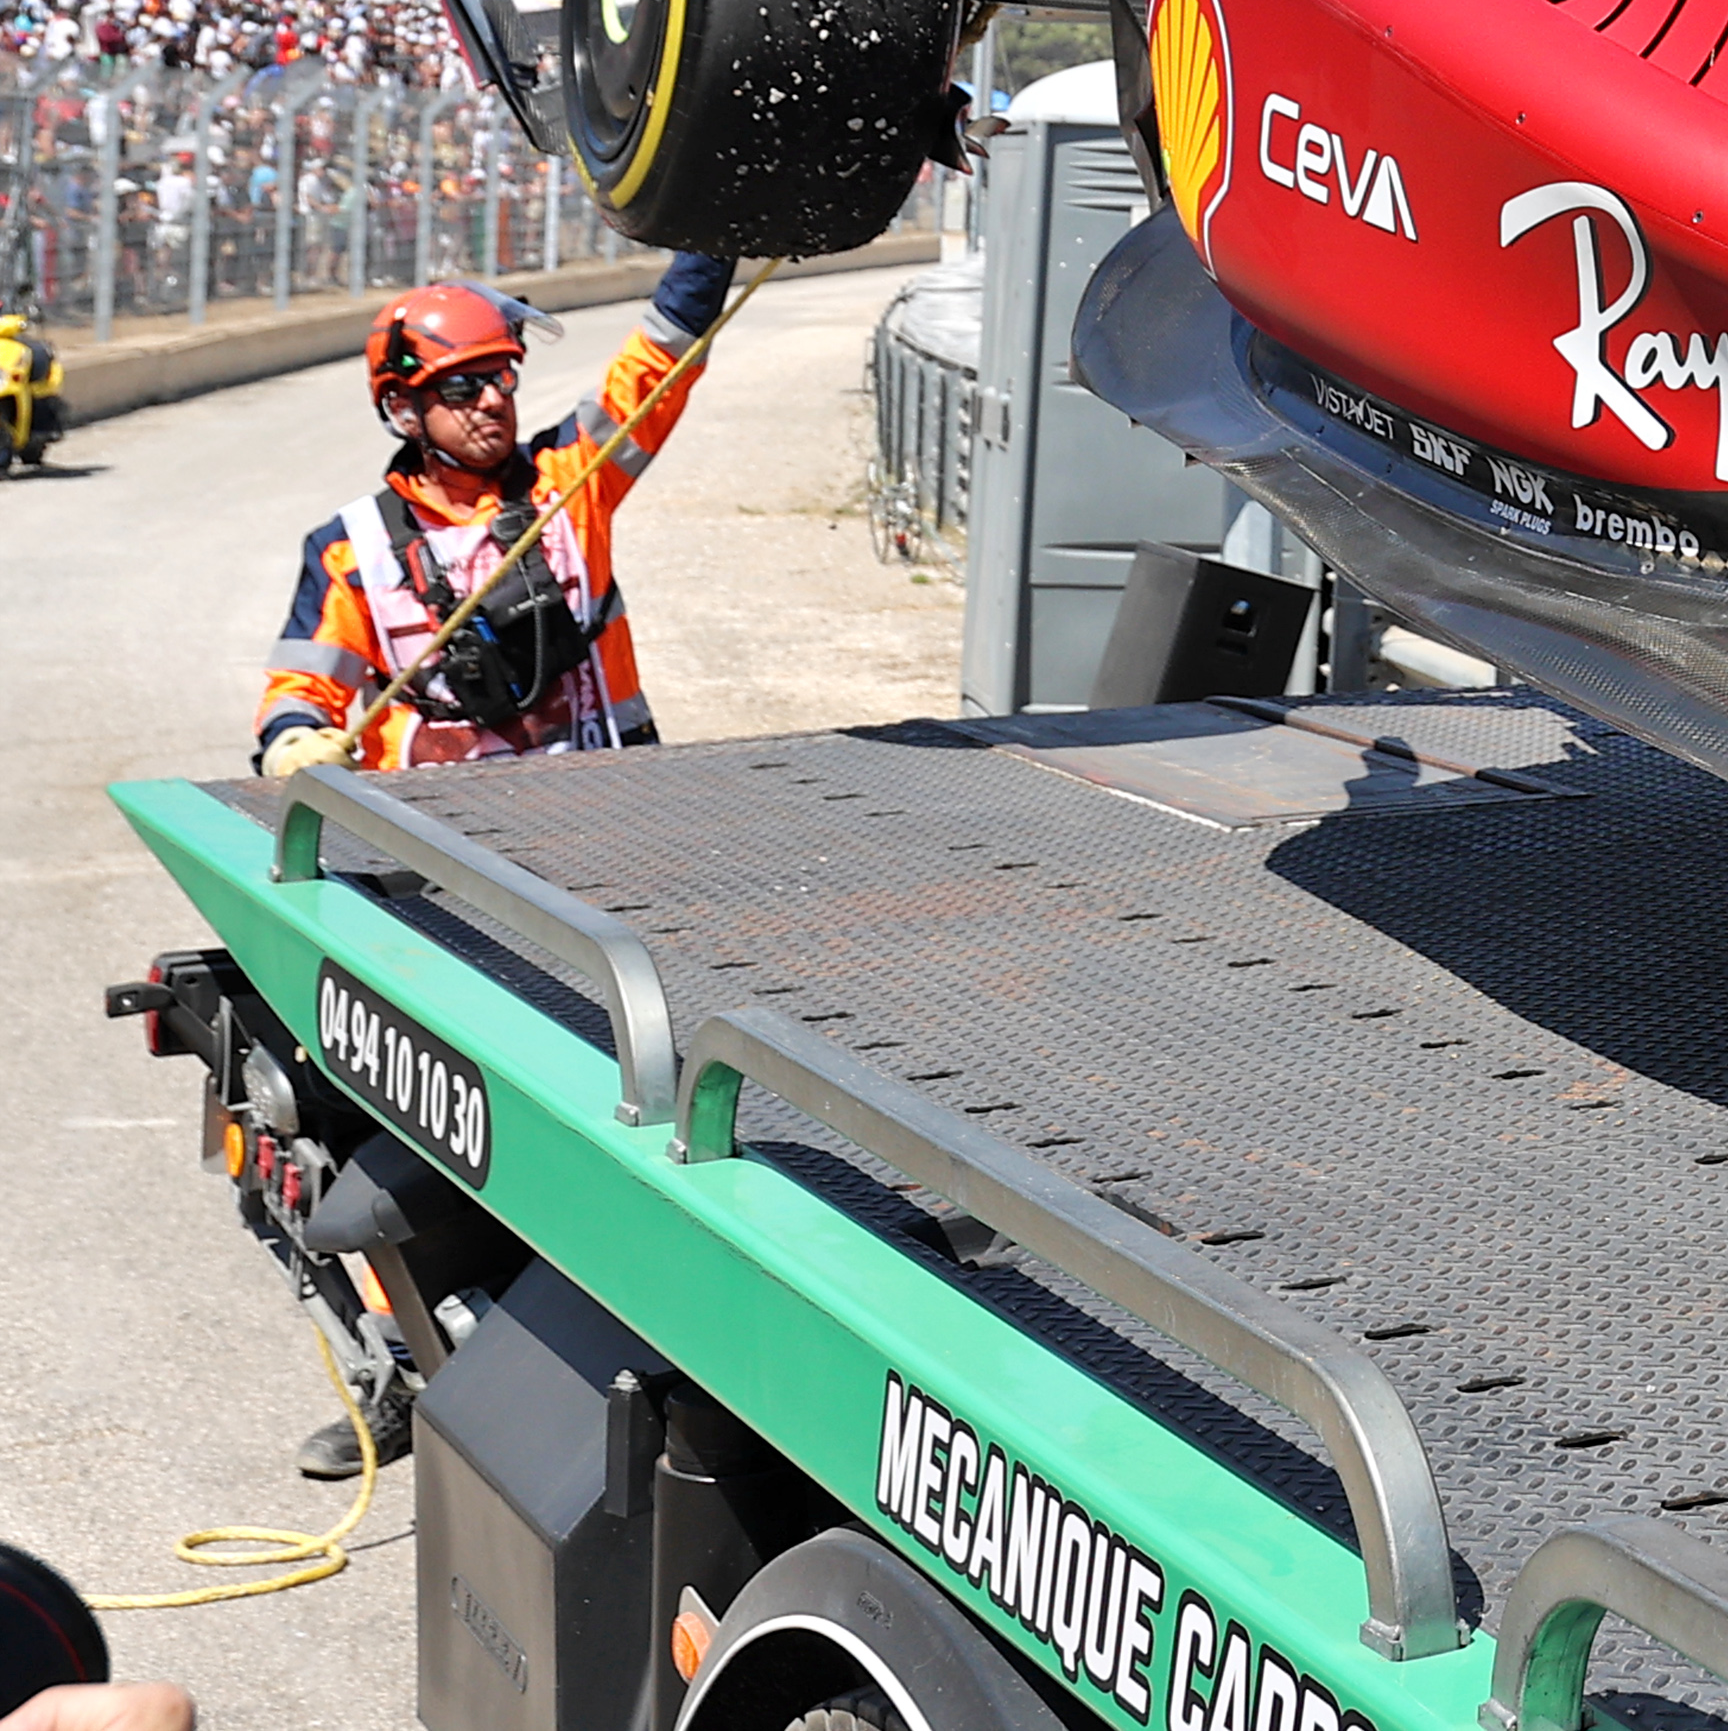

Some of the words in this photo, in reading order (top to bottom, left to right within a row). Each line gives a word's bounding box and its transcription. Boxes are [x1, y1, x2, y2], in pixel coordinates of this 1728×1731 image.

[1310, 373, 1395, 441] VISTAJET
[1407, 421, 1472, 476] SKF
[1485, 455, 1555, 516] NGK
[1489, 498, 1519, 524] SPARK
[1519, 506, 1553, 536] PLUGS
[1571, 493, 1701, 558] brembo
[320, 976, 349, 1062] 04
[350, 1000, 381, 1088] 94
[384, 1026, 414, 1113] 10
[417, 1050, 448, 1140] 10
[449, 1073, 485, 1168] 30
[876, 1371, 1164, 1719] MECANIQUE
